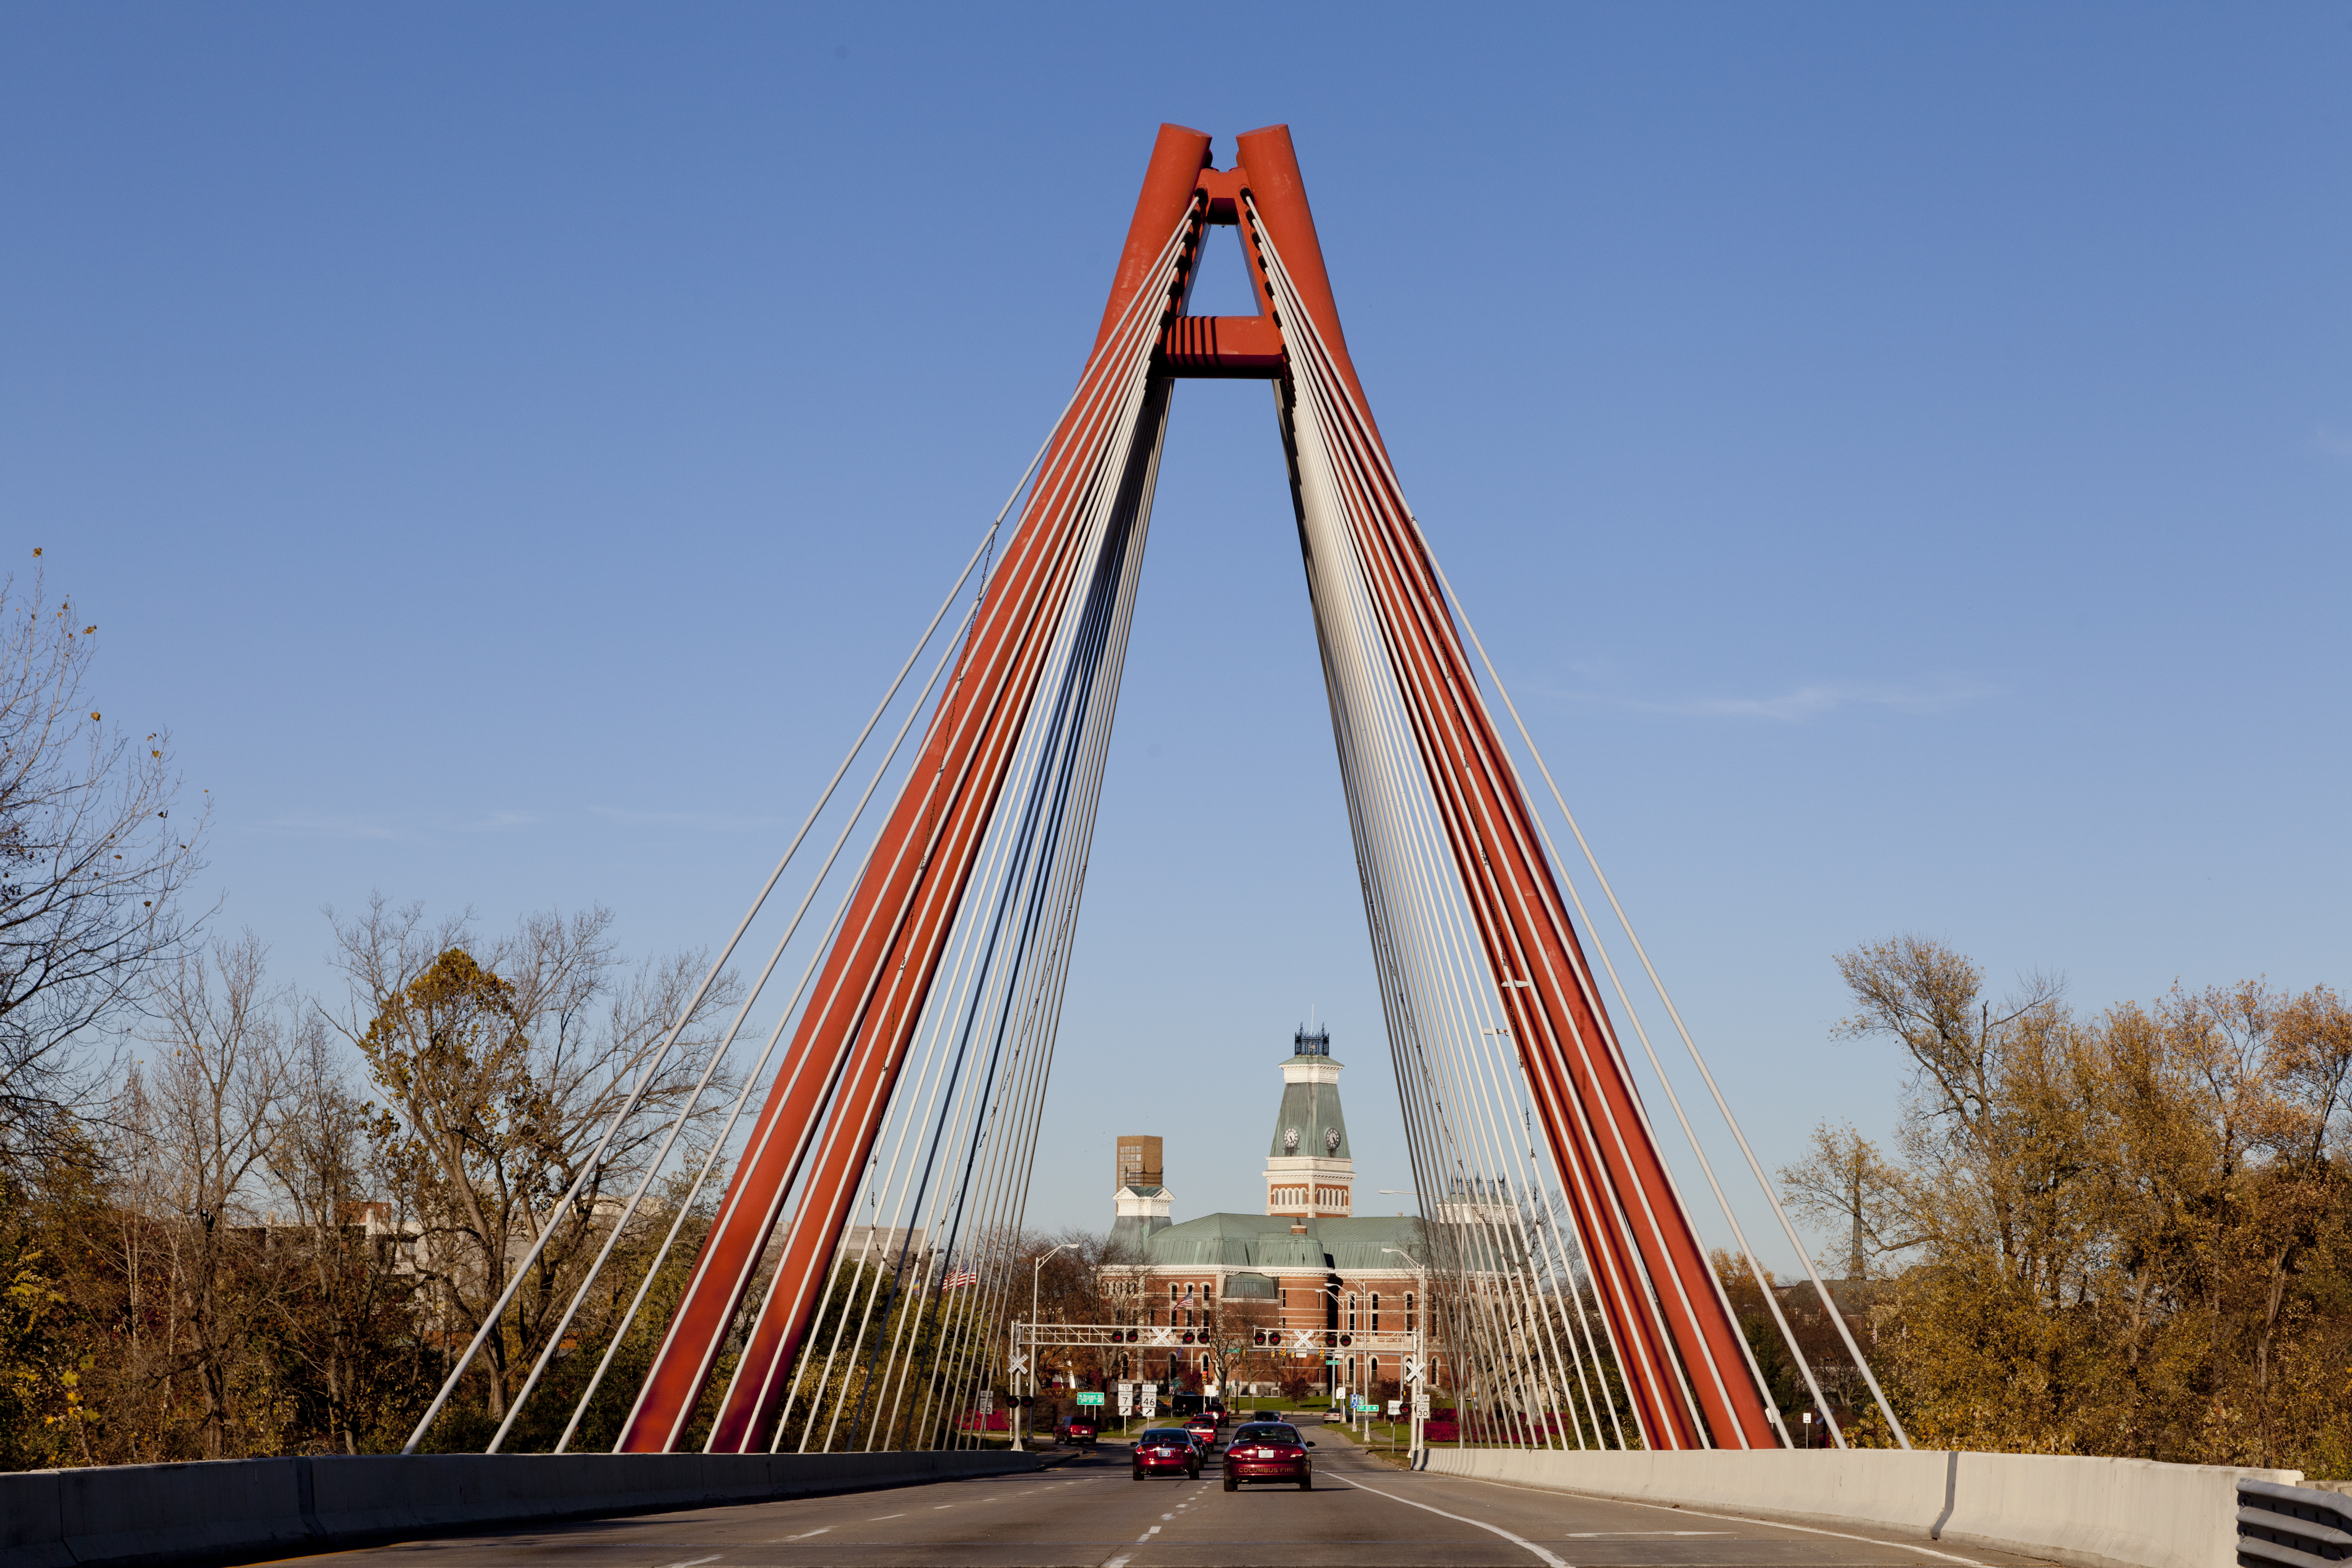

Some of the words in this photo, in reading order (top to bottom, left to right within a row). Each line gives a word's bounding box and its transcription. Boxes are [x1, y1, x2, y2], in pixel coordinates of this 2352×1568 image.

[1153, 1328, 1170, 1345] CROSSING
[1295, 1330, 1312, 1348] CROSSING
[1009, 1355, 1027, 1372] CROSSING
[1407, 1363, 1424, 1380] CROSSING
